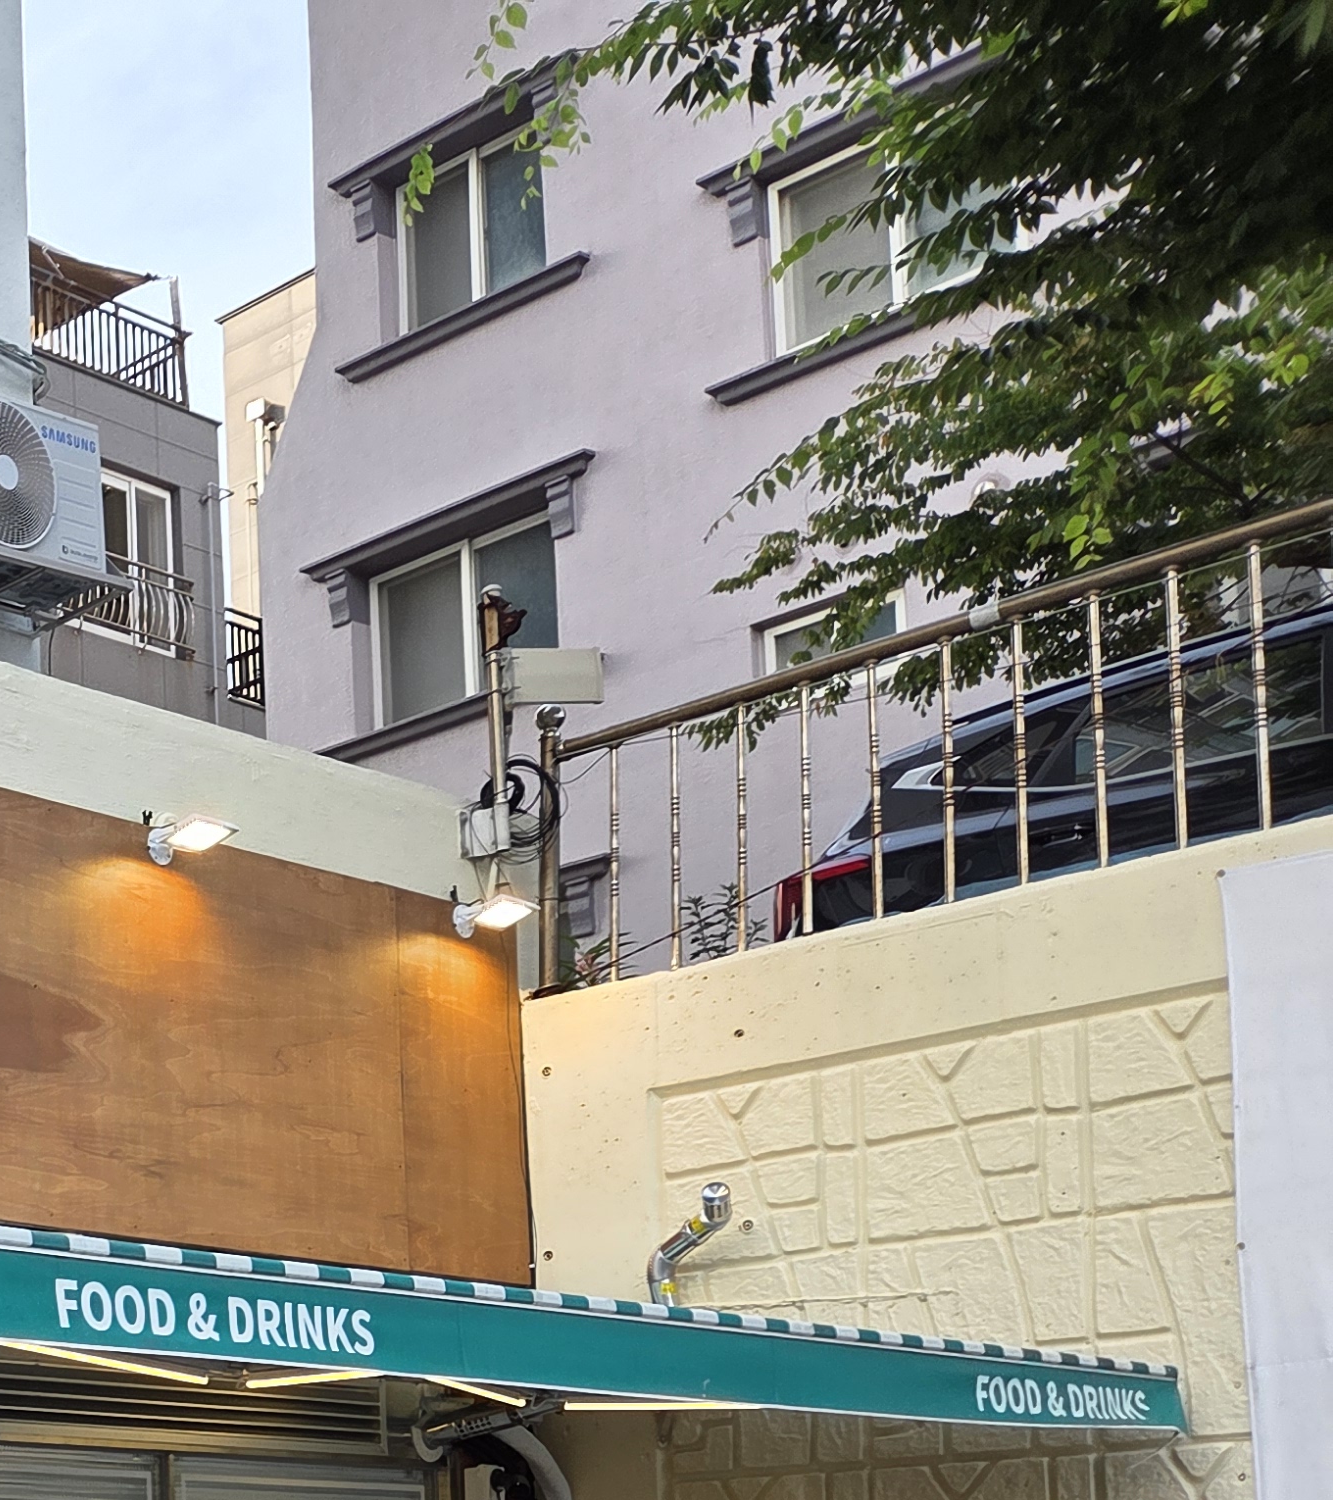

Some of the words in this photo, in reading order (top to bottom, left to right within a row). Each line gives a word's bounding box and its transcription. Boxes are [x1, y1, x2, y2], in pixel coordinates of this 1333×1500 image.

[41, 425, 97, 454] SAMSUNG
[55, 1278, 176, 1337] FOOD
[188, 1292, 220, 1342] &
[228, 1296, 376, 1357] DRINKS
[976, 1375, 1042, 1415] FOOD
[1047, 1381, 1067, 1417] &
